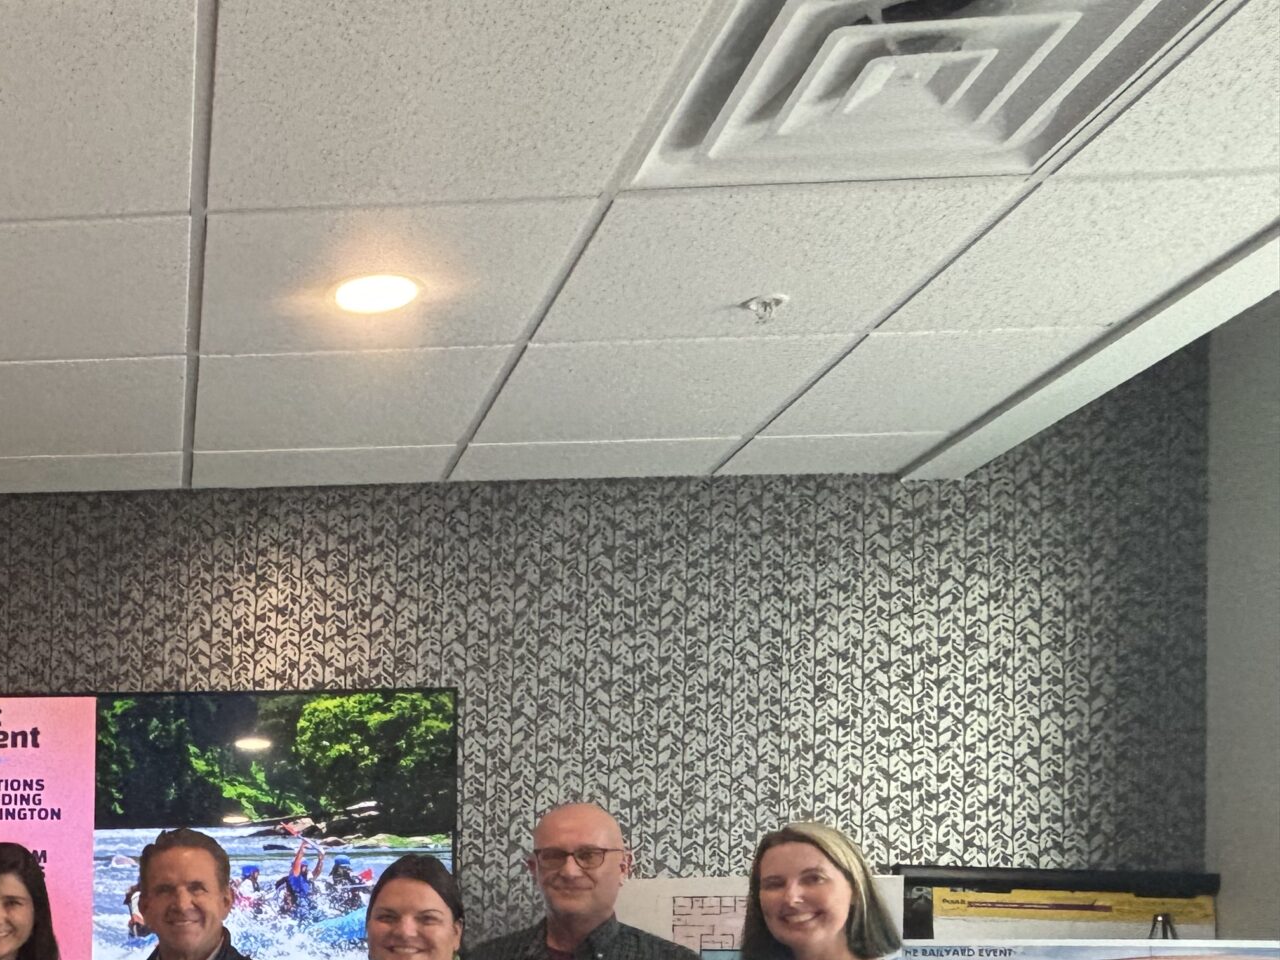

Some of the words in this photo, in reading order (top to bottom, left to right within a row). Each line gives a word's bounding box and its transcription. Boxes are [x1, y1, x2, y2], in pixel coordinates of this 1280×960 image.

[904, 948, 919, 958] HE
[921, 948, 976, 958] RAILYARD
[978, 948, 1014, 958] EVENT
